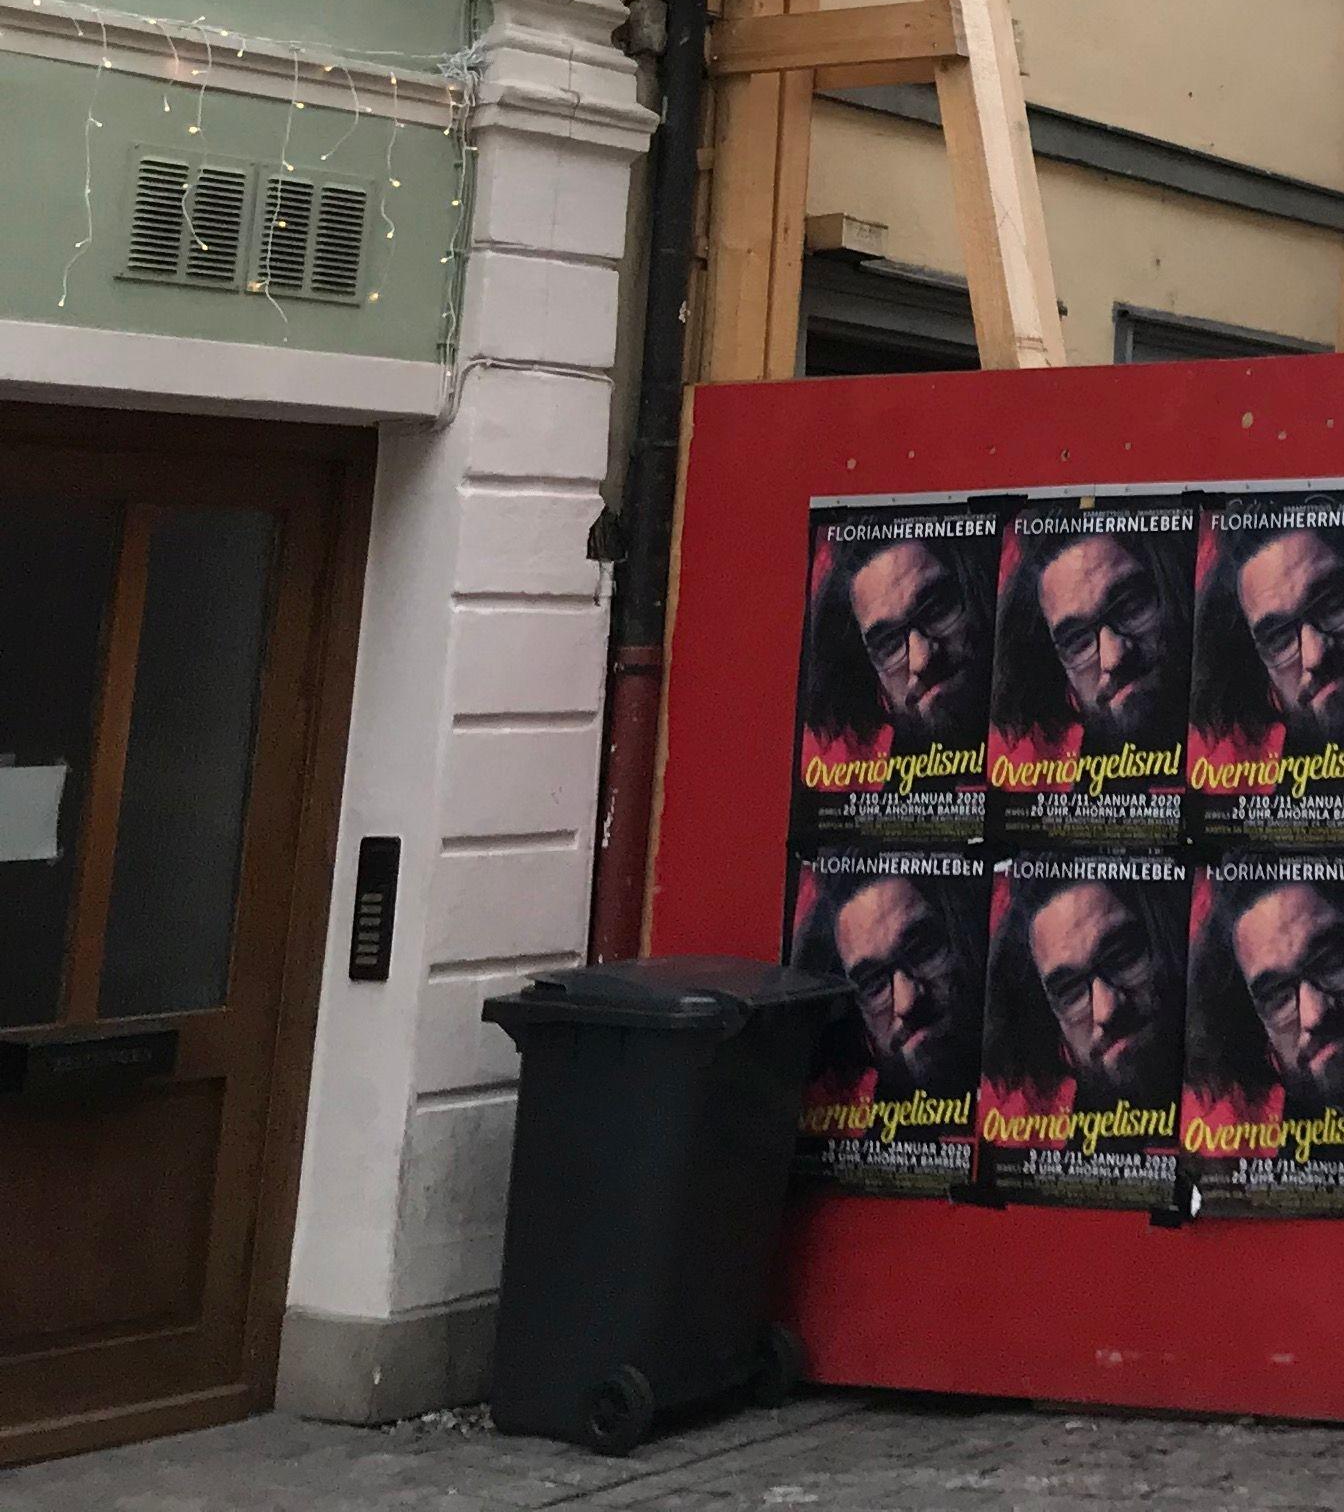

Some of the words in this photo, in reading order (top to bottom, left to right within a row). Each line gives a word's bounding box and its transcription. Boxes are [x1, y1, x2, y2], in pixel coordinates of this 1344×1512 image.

[805, 741, 986, 796] Overnörgelism!
[991, 741, 1182, 797] Overnörgelism!
[906, 792, 953, 804] JANUAR
[956, 792, 986, 805] 2020
[1097, 794, 1147, 806] JANUAR
[1150, 794, 1181, 807] 2020
[843, 804, 856, 816] 20
[937, 804, 986, 816] BAMBERG
[1030, 806, 1044, 817] 20
[1129, 806, 1181, 819] BAMBERG
[1232, 808, 1246, 820] 20
[983, 1098, 1176, 1156] Overnörgelism!
